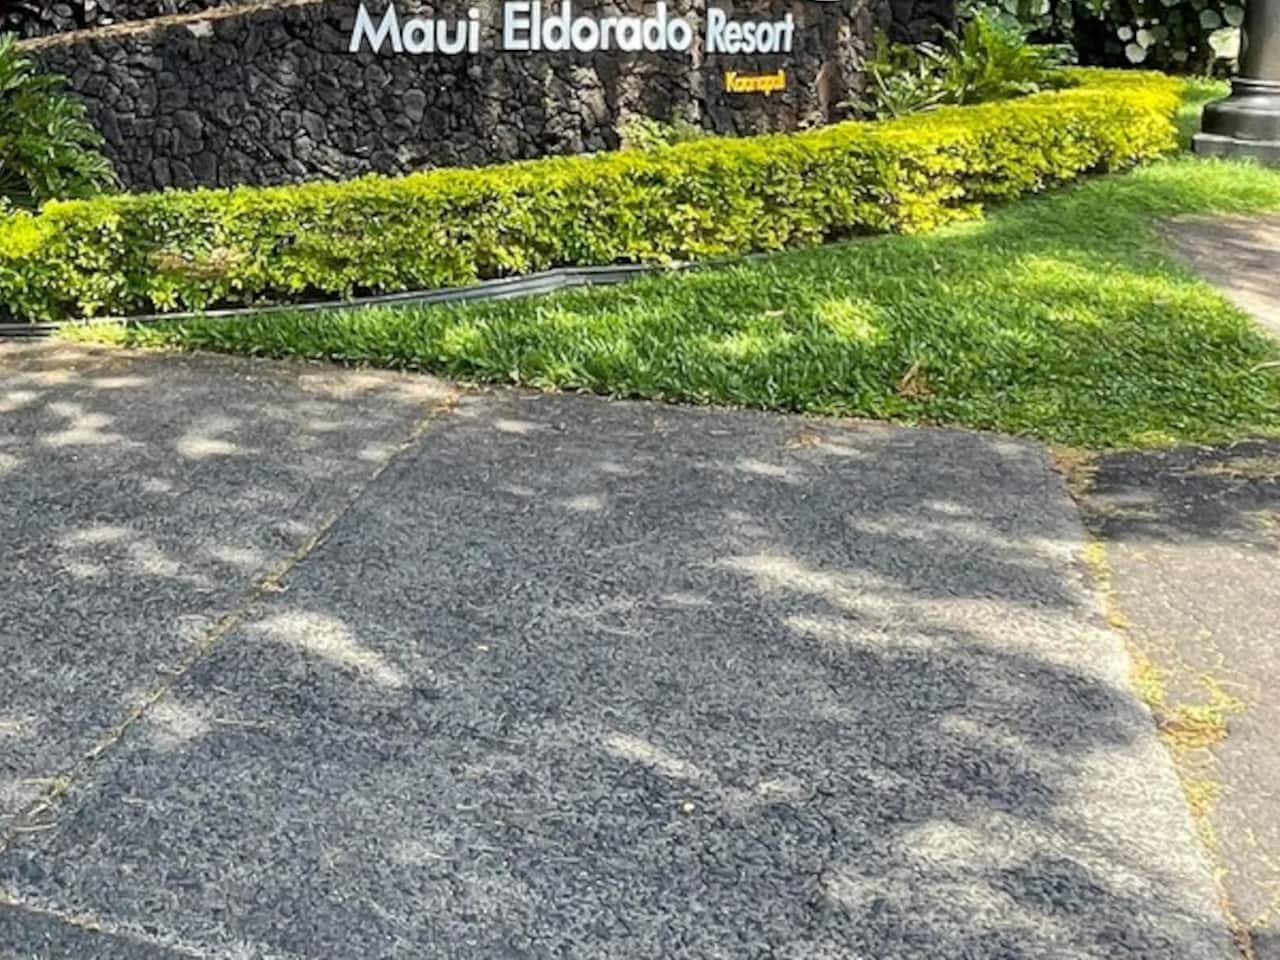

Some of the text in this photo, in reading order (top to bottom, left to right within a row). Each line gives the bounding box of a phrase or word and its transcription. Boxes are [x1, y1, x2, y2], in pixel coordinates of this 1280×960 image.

[349, 0, 795, 54] Maui Eldorado Resort
